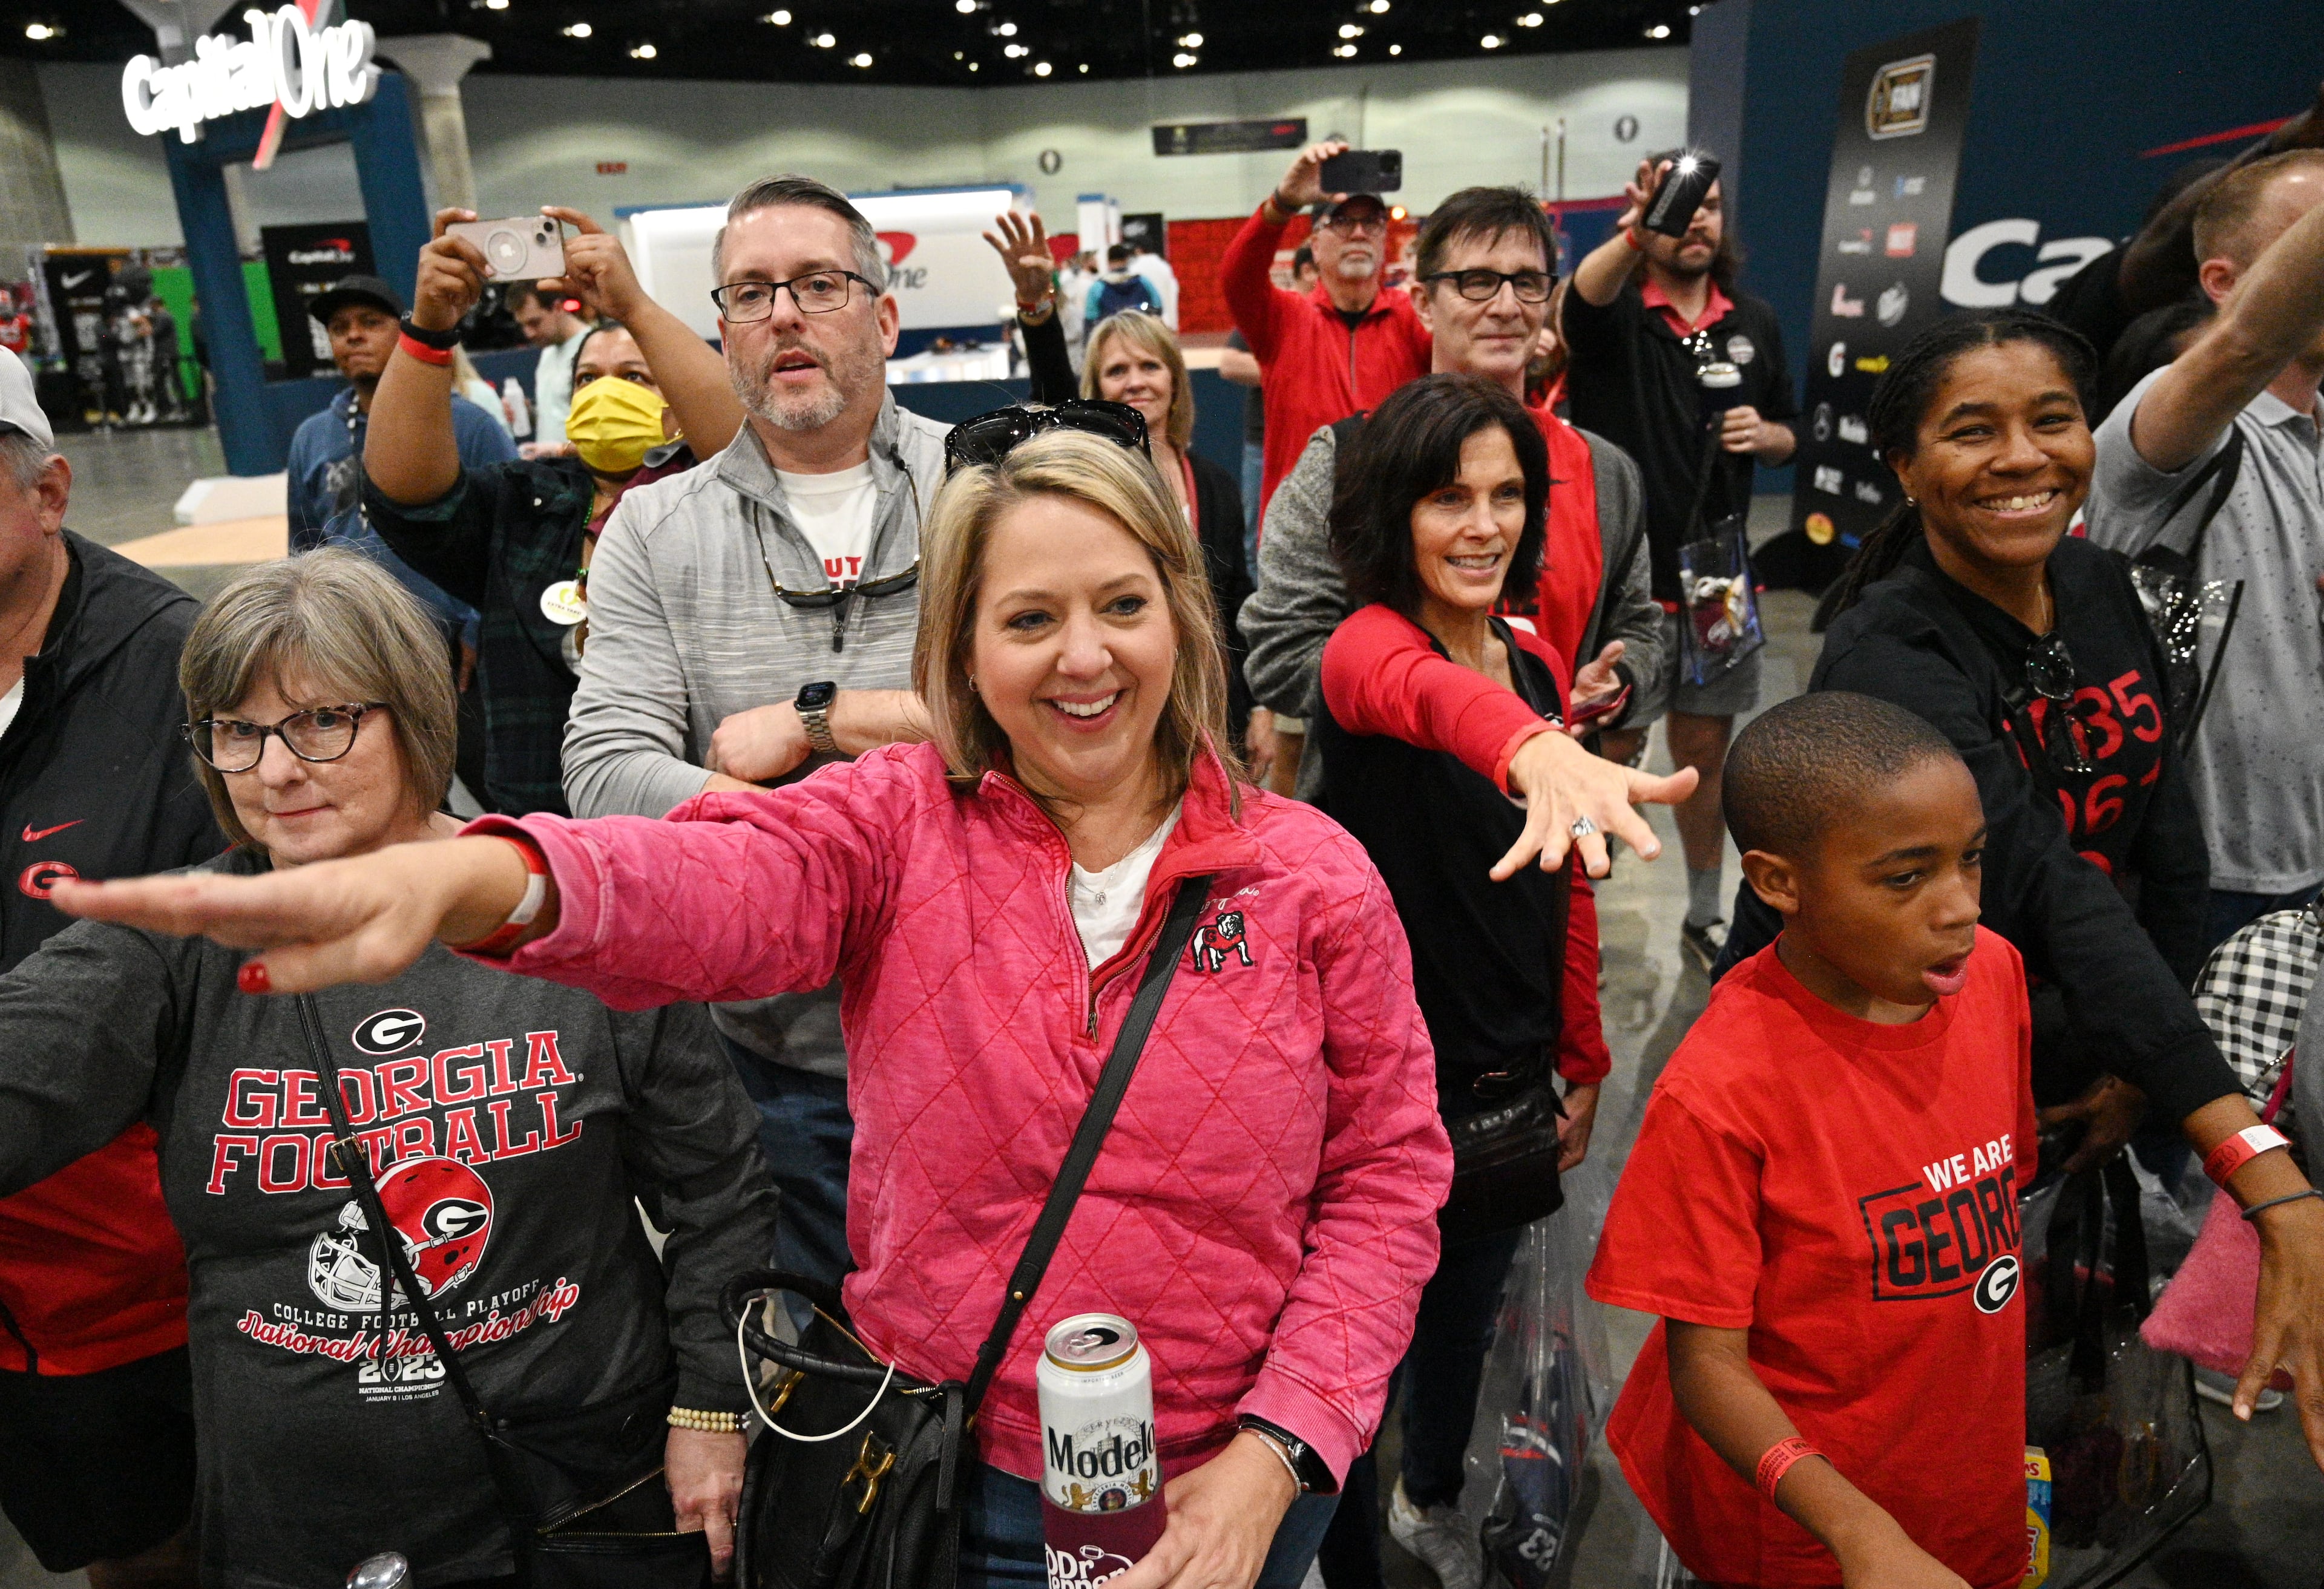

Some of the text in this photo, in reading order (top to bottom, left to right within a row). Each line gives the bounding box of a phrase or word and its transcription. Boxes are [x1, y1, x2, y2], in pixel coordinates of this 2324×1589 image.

[351, 1008, 425, 1055] G
[222, 1030, 576, 1129] GEORGIA
[206, 1091, 583, 1195] FOOTBALL
[1922, 1133, 2014, 1193] WE ARE
[421, 1197, 488, 1239] G
[274, 1278, 539, 1329] COLLEGE FOOTBLL PLAYOFF
[1973, 1254, 2020, 1314] G
[237, 1309, 369, 1363] National
[358, 1380, 445, 1395] NATIONAL CHAMPIONSHIP
[413, 1389, 439, 1400] ANGELES
[1048, 1420, 1156, 1479] Modelo
